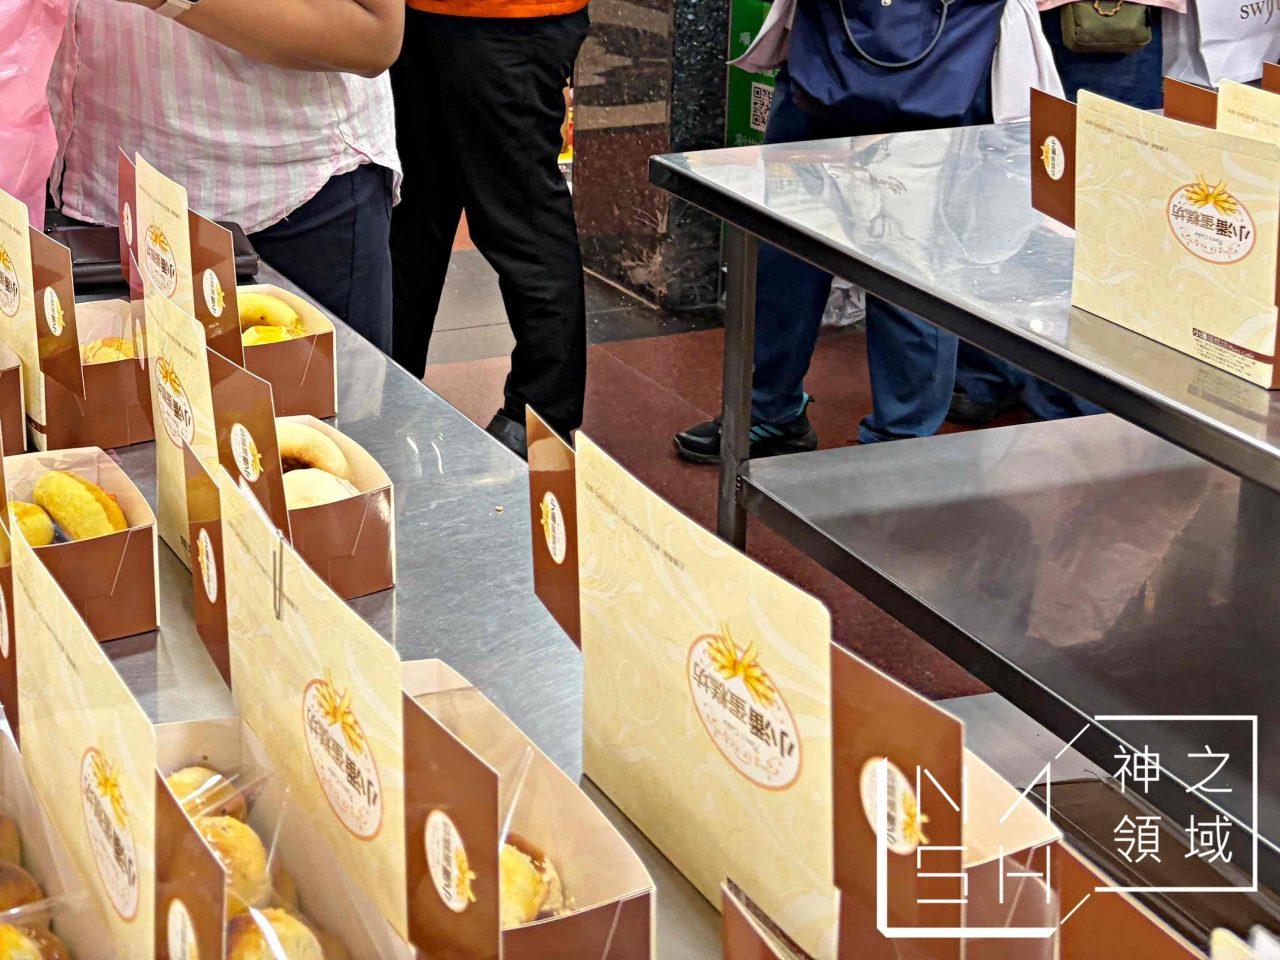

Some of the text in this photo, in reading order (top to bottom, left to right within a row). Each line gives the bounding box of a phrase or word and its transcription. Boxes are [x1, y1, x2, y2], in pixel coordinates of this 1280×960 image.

[1171, 204, 1251, 242] 小潘蛋糕坊
